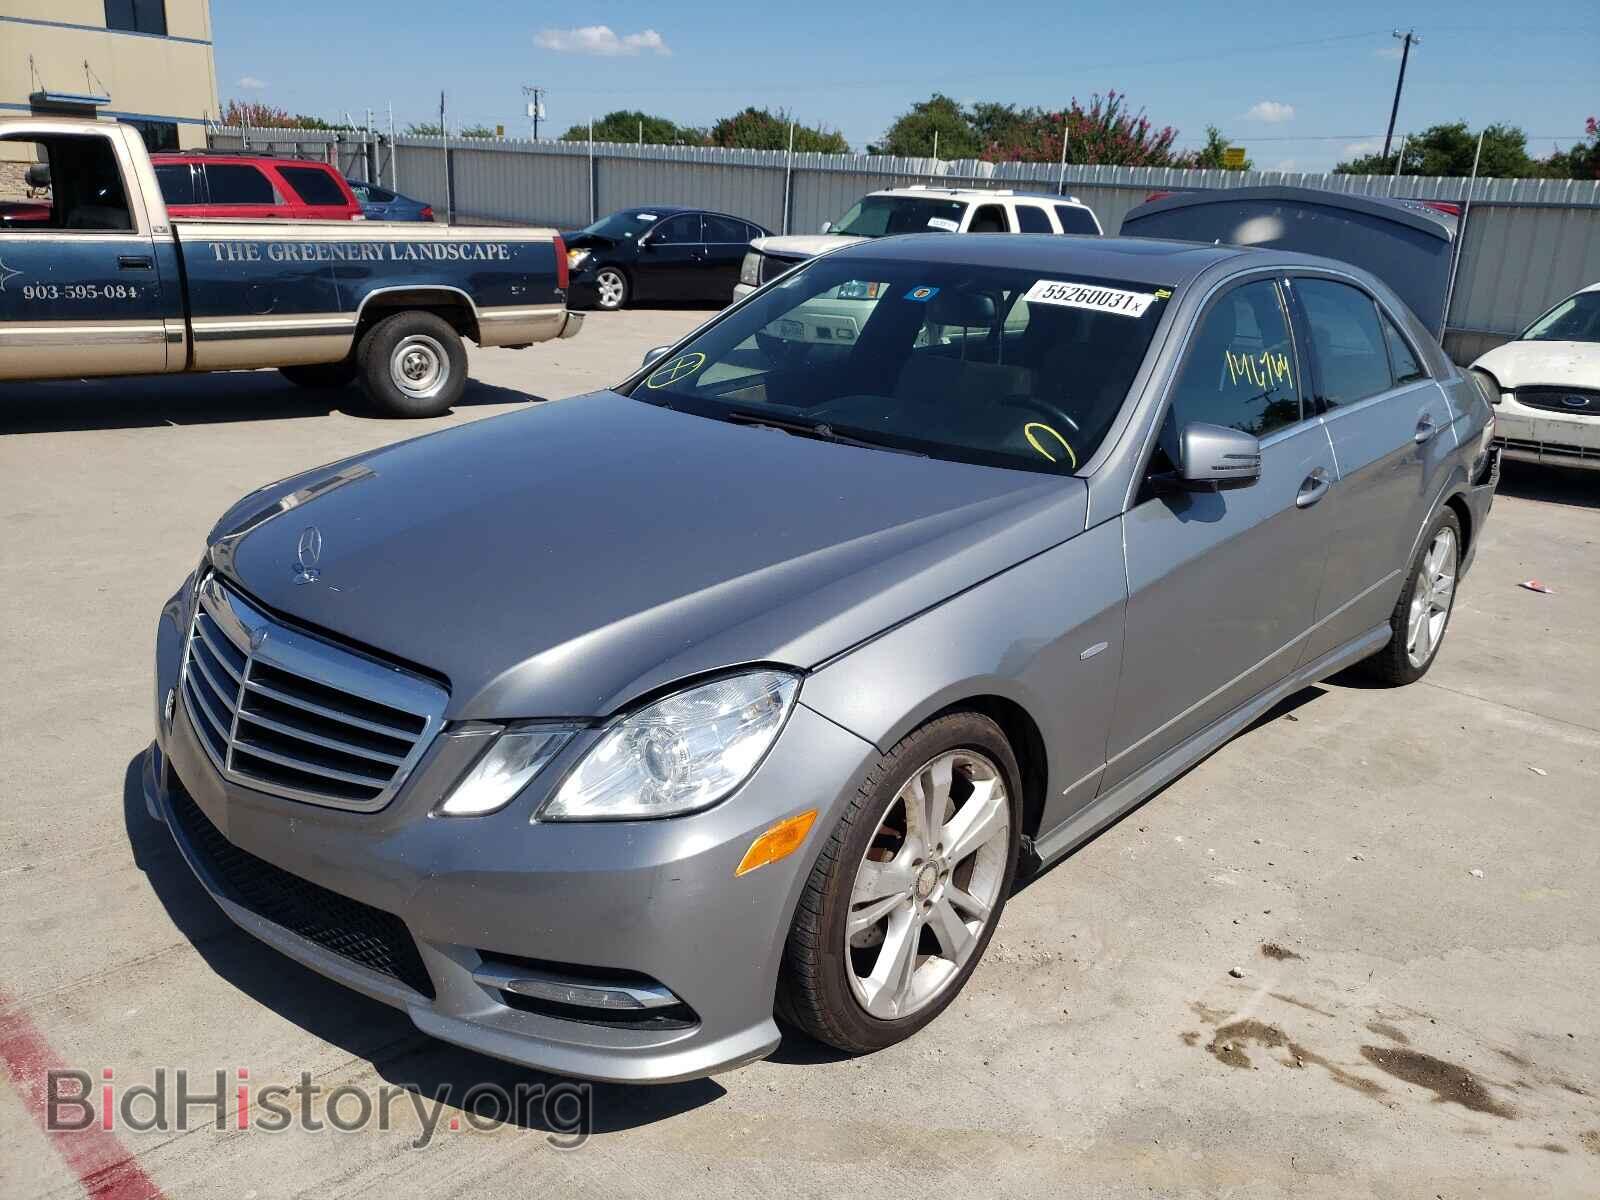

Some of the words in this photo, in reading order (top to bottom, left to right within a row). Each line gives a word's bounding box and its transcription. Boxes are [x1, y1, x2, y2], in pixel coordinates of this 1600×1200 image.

[208, 242, 261, 261] THE
[267, 242, 385, 261] GREENERY
[391, 243, 511, 261] LANDSCAPE
[1042, 284, 1134, 309] 55260031
